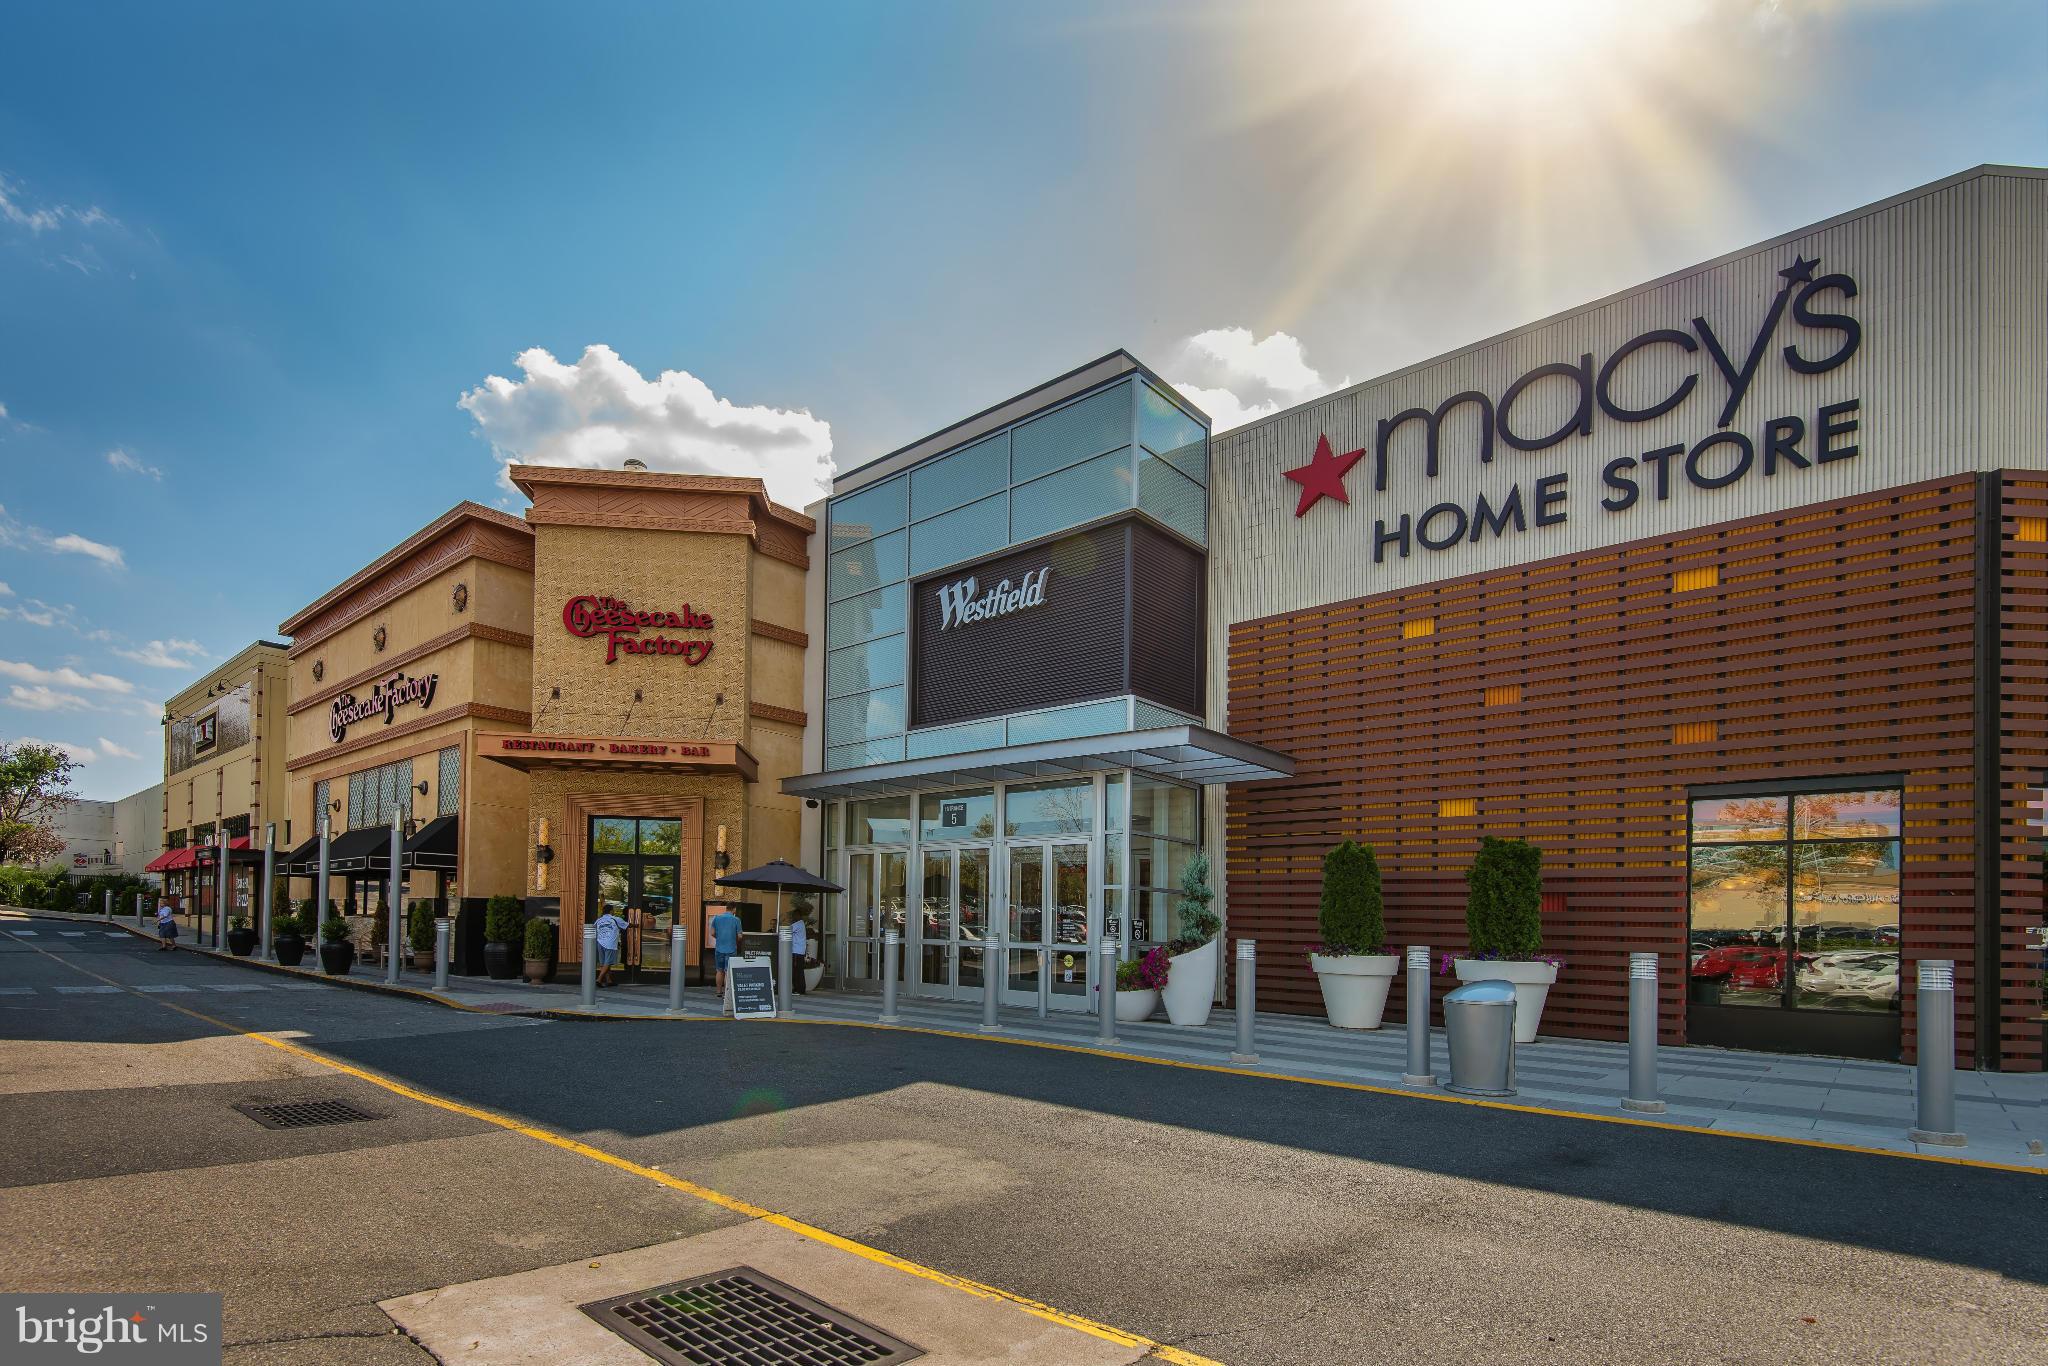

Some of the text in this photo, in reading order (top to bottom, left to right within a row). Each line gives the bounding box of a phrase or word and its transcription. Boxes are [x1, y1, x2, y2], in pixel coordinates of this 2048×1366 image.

[1374, 398, 1860, 563] HOME STORE
[563, 595, 714, 637] Cheesecake
[600, 595, 627, 610] The
[936, 566, 1050, 632] Westfield
[592, 626, 714, 666] Factory
[329, 671, 438, 743] Cheesecake Factory
[340, 693, 354, 708] The
[502, 739, 710, 757] RESTAURANT BAKERY BAR
[951, 813, 957, 825] 5
